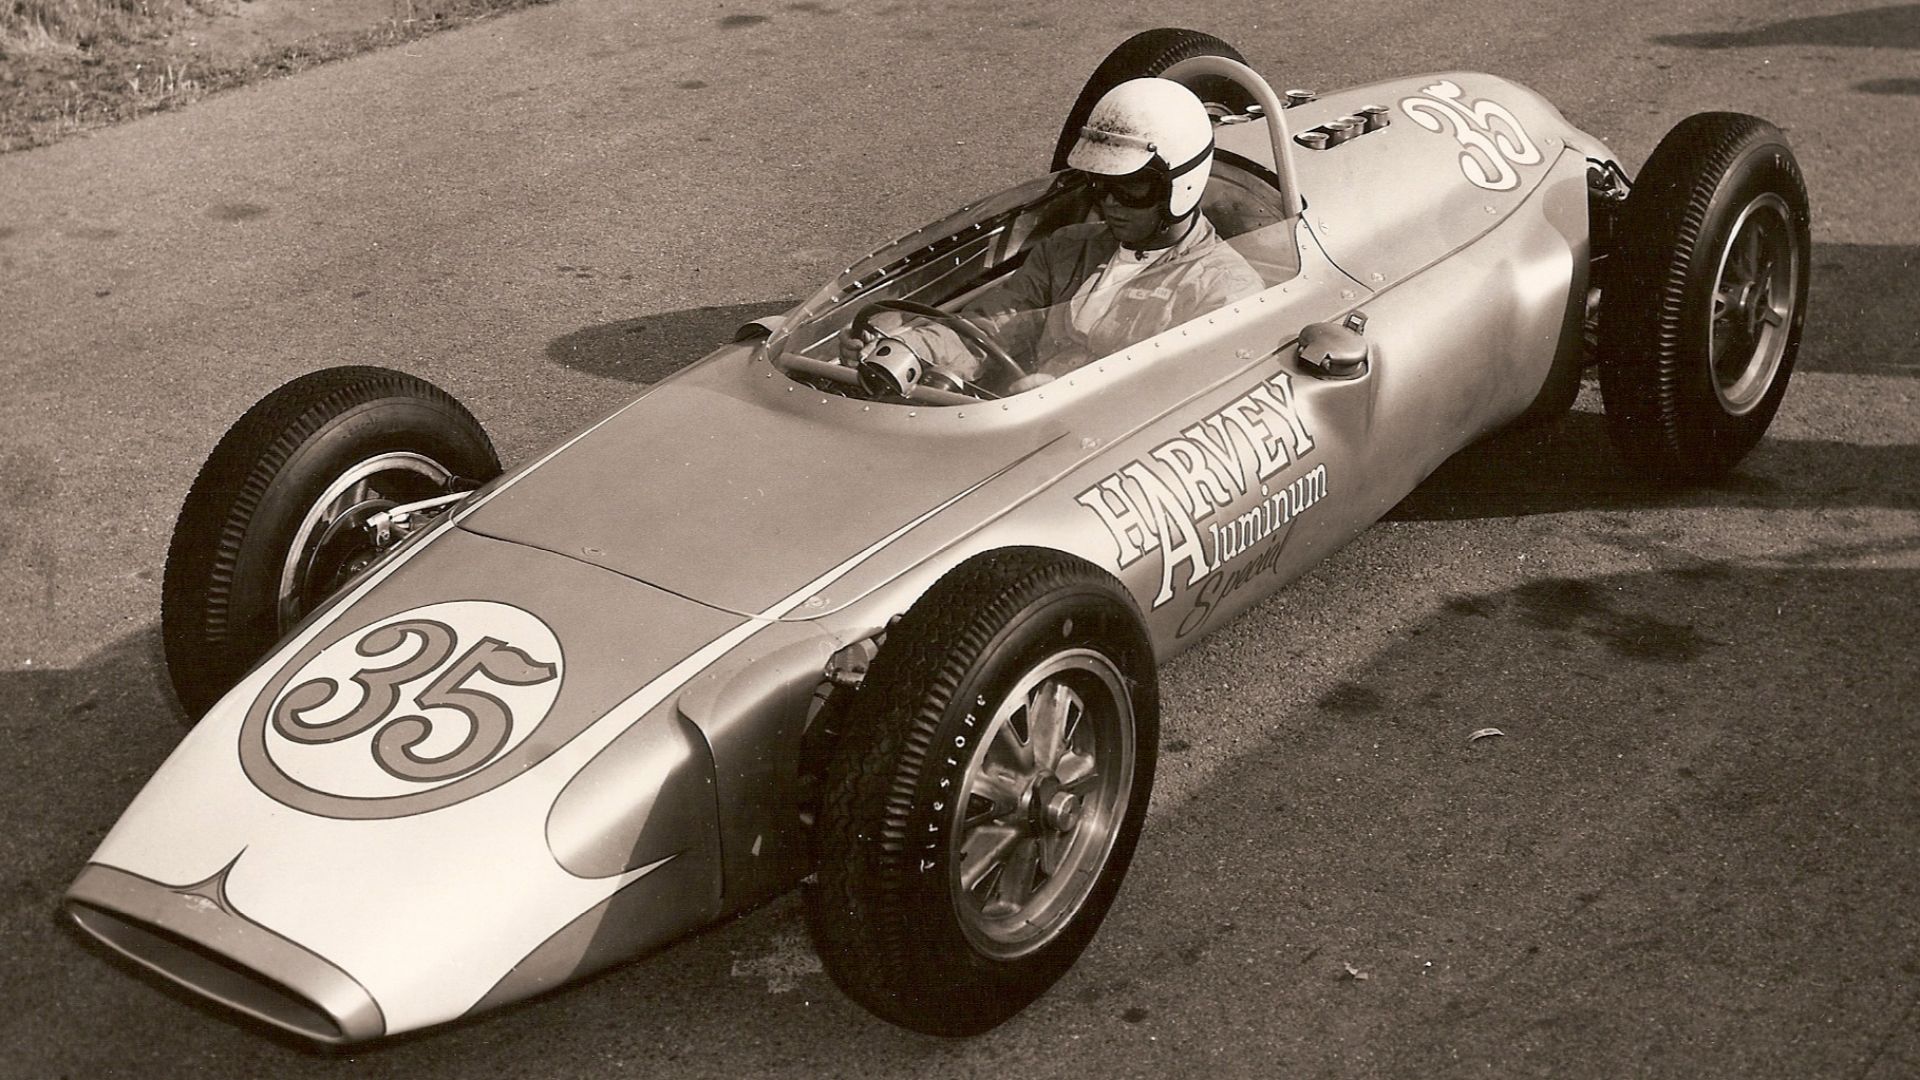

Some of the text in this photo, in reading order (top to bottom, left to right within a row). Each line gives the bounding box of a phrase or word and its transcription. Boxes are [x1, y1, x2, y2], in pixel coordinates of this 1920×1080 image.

[1398, 79, 1545, 193] 35
[1074, 369, 1316, 571] HARVEY
[1150, 462, 1329, 612] Aluminum
[271, 618, 558, 783] 35
